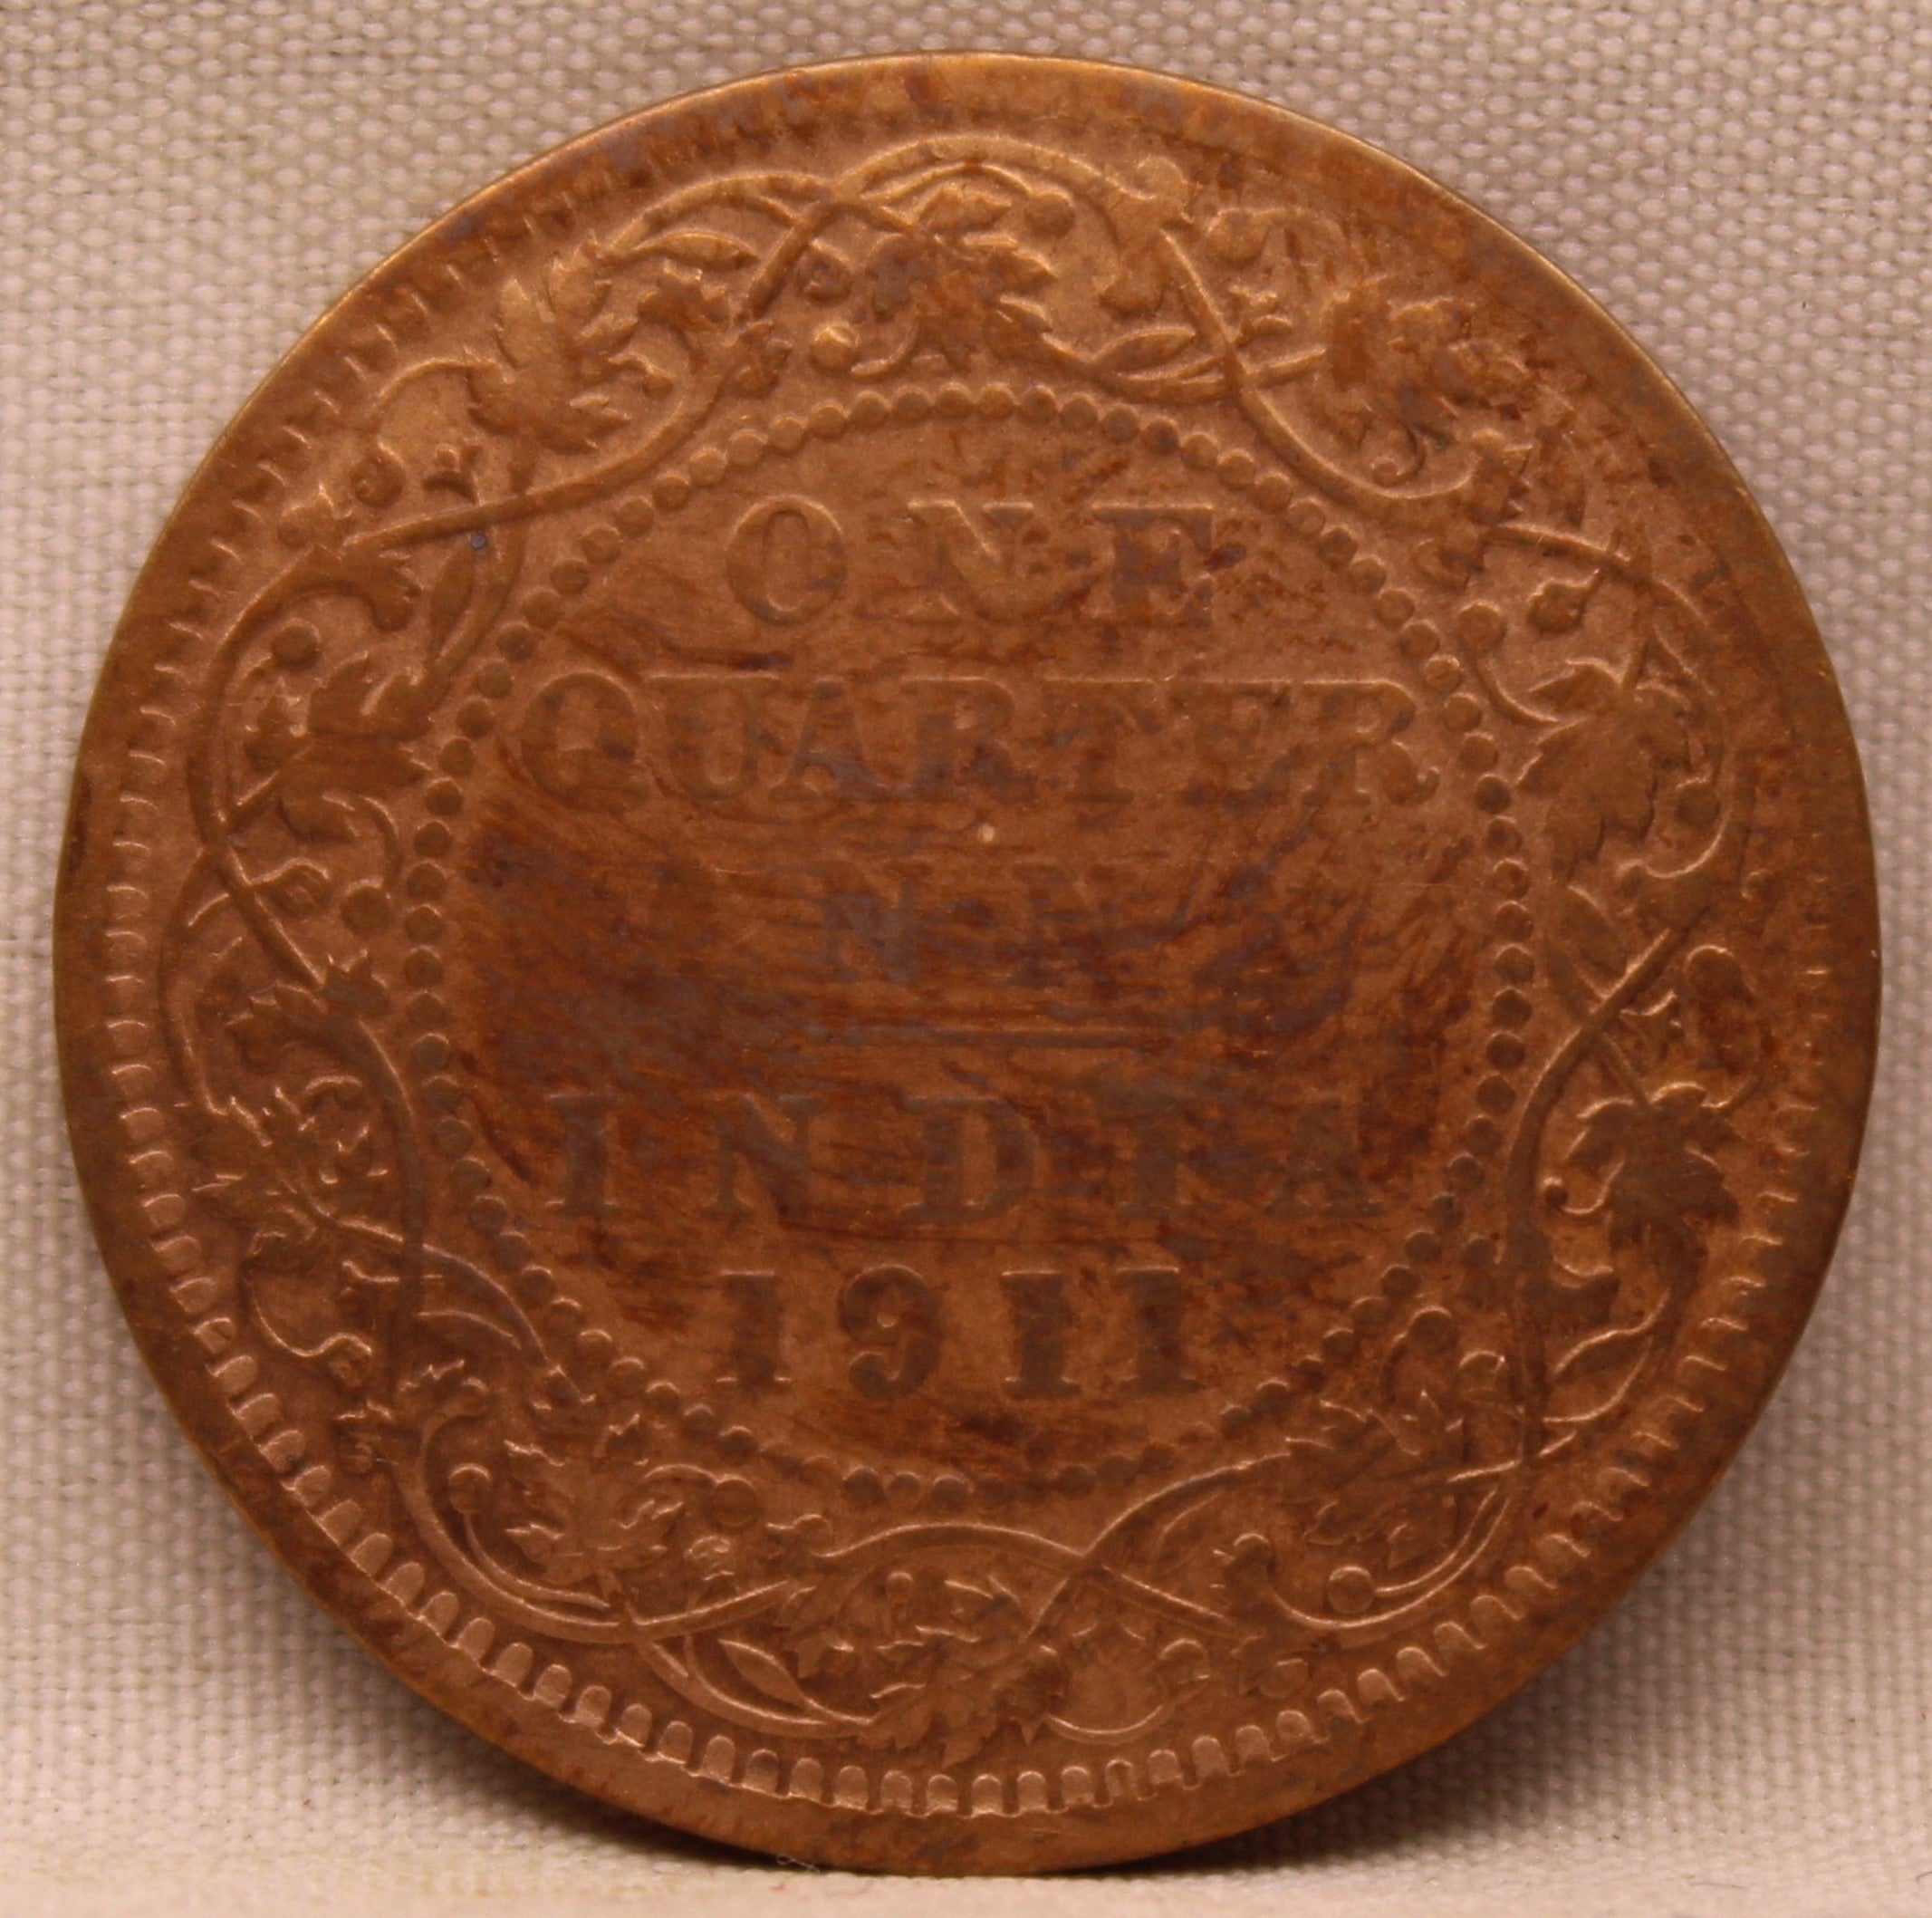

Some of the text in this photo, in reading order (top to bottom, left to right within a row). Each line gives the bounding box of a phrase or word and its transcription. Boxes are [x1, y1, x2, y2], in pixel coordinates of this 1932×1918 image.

[732, 494, 1223, 627] ONE
[518, 670, 1441, 808] QUARTER
[545, 1091, 1384, 1225] INDIA
[714, 1266, 1190, 1402] 1911
